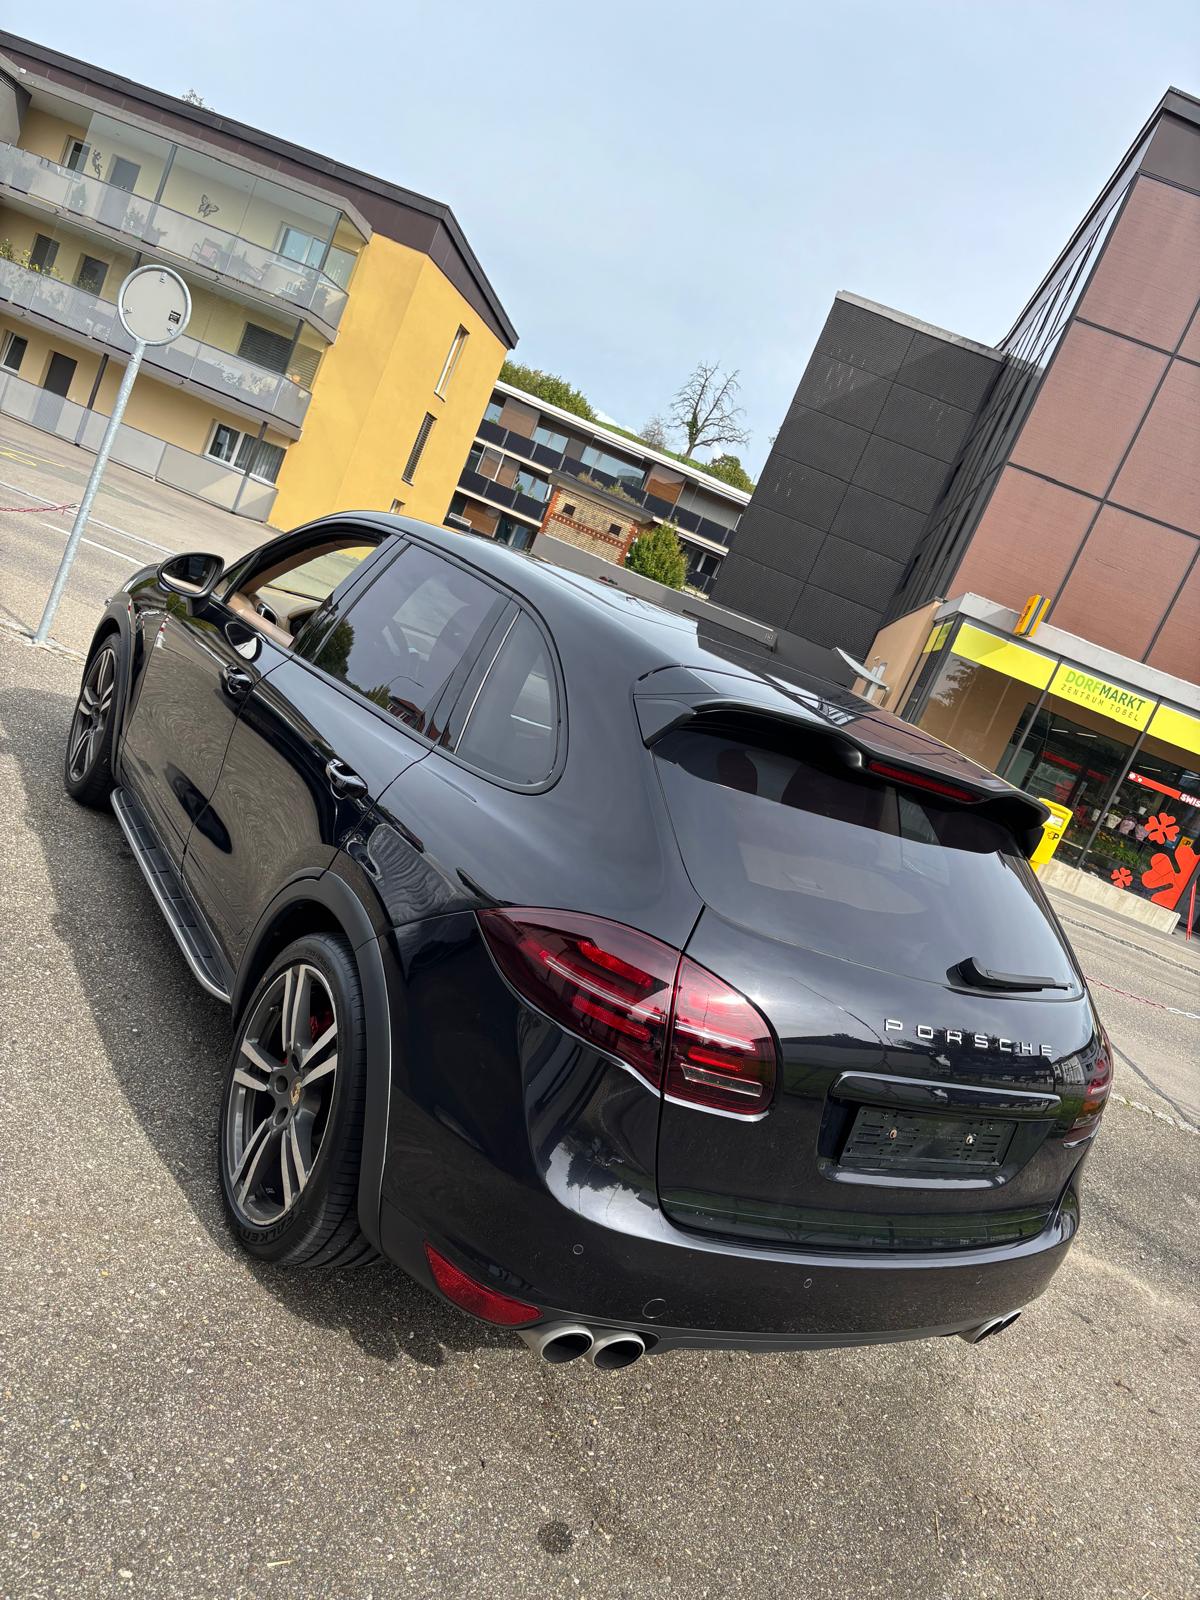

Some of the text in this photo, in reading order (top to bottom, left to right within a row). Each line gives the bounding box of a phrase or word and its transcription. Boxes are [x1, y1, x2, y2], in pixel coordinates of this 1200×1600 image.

[1060, 683, 1139, 722] ZENTRUM TOBEL
[1065, 670, 1146, 711] DORFMARKT
[884, 1018, 1052, 1057] PORSCHE
